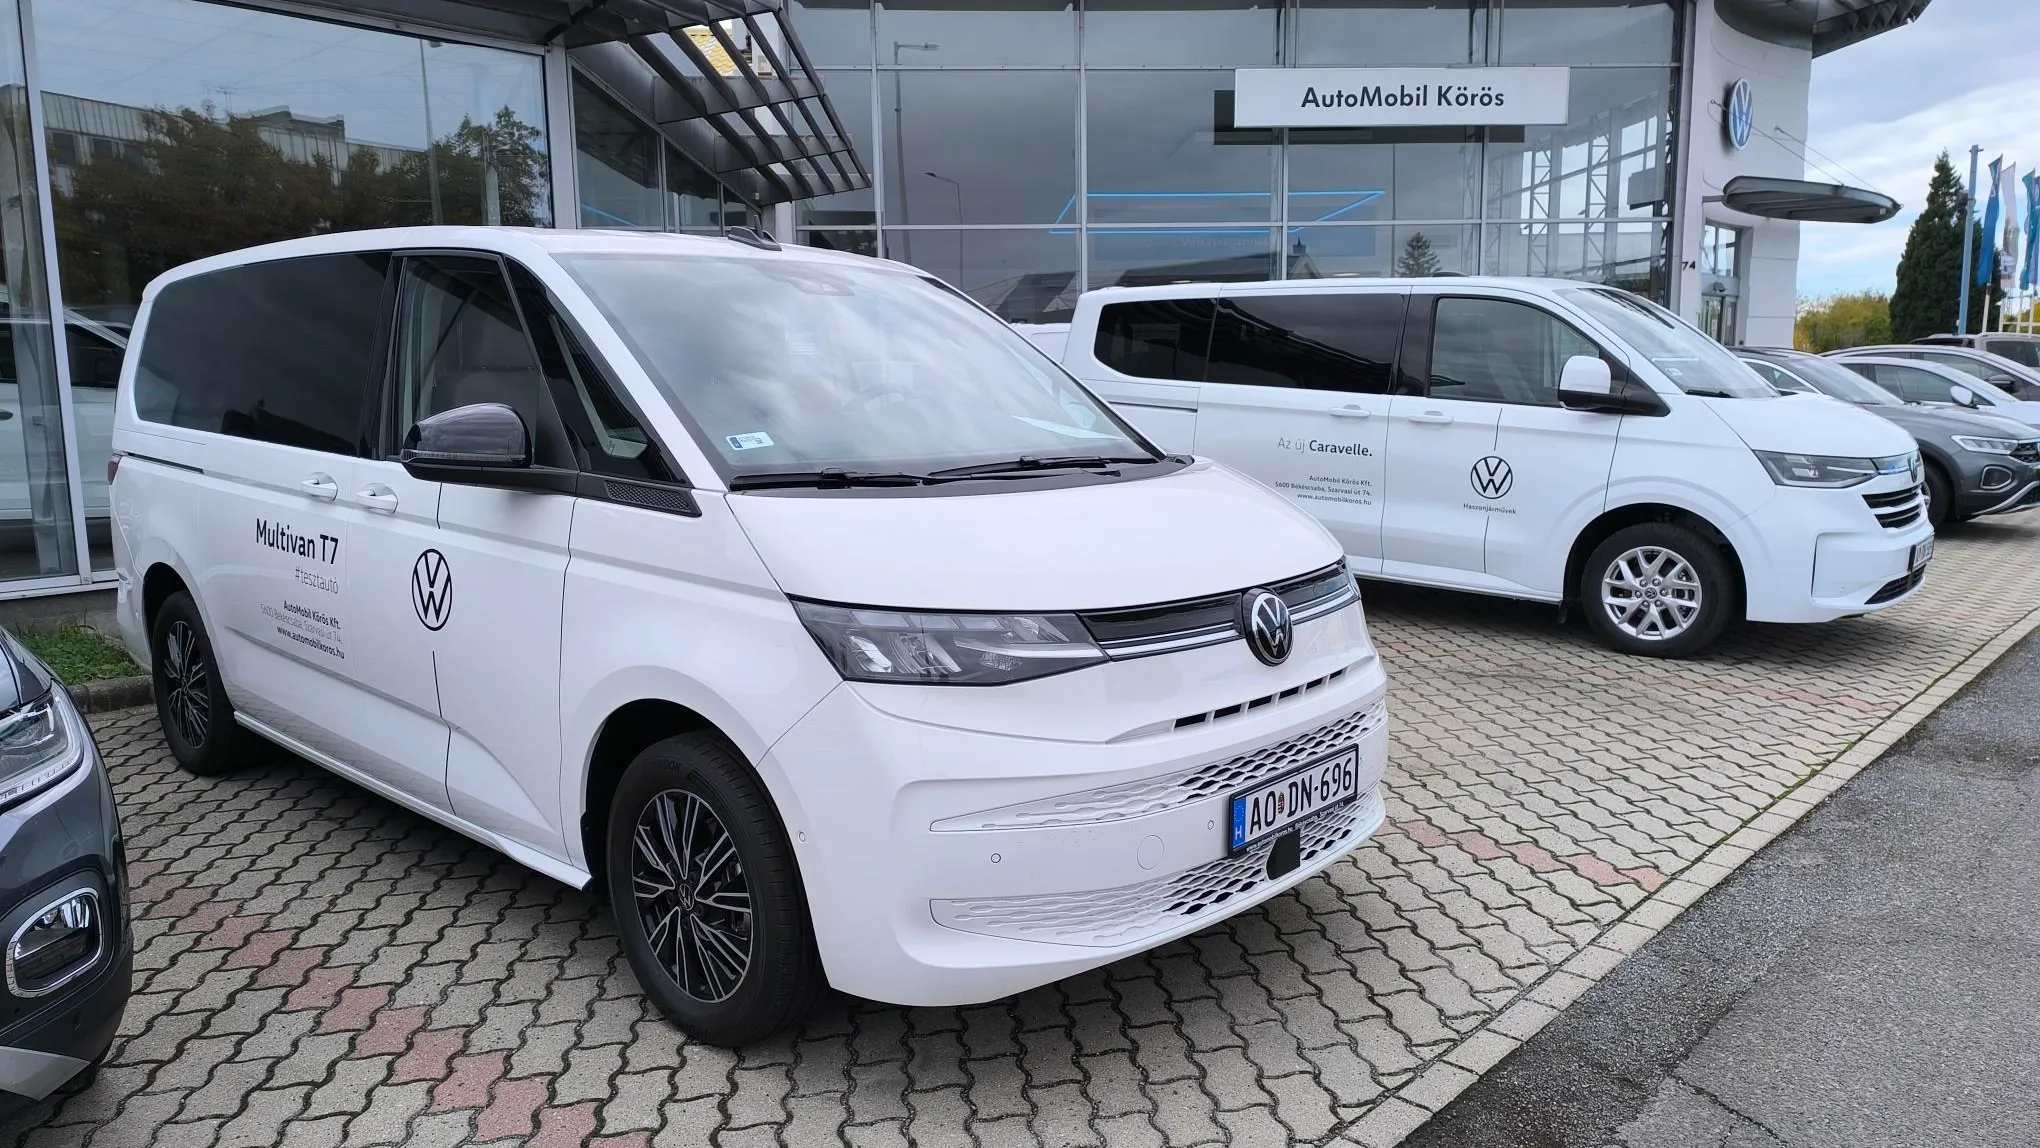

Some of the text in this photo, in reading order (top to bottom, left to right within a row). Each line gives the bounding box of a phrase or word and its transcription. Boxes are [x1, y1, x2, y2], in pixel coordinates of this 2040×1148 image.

[1301, 85, 1505, 108] AutoMobil Körös
[1680, 260, 1696, 270] 74
[1277, 437, 1373, 457] Az új Caravelle.
[1275, 481, 1373, 497] 5600 Békéscsaba, Szarvasi út 74.
[1309, 475, 1373, 487] AutoMobil Körös Kft.
[1297, 493, 1372, 506] www.automobilkoros.hu
[256, 518, 339, 565] Multivan T7
[295, 566, 339, 594] #tesztautó
[284, 600, 341, 630] AutoMobil Körös Kft.
[277, 626, 345, 660] www.automobilkoros.hu
[1235, 757, 1352, 839] H AO DN-696
